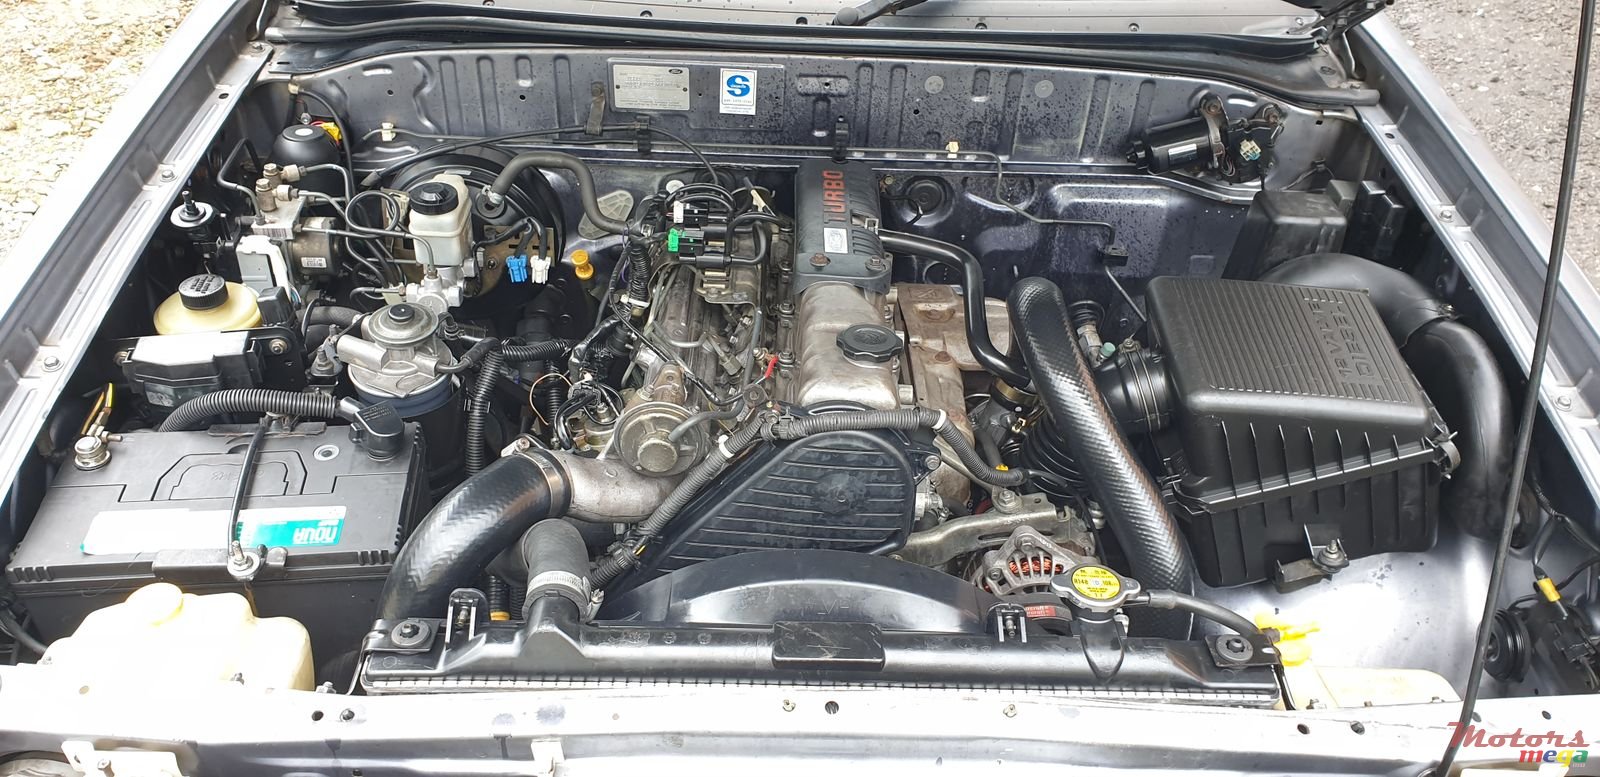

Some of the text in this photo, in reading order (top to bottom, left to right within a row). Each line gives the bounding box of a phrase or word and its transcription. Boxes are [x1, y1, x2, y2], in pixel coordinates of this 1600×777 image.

[823, 170, 847, 224] TURBO
[1308, 302, 1342, 354] VALVE
[1329, 305, 1375, 377] DIESEL
